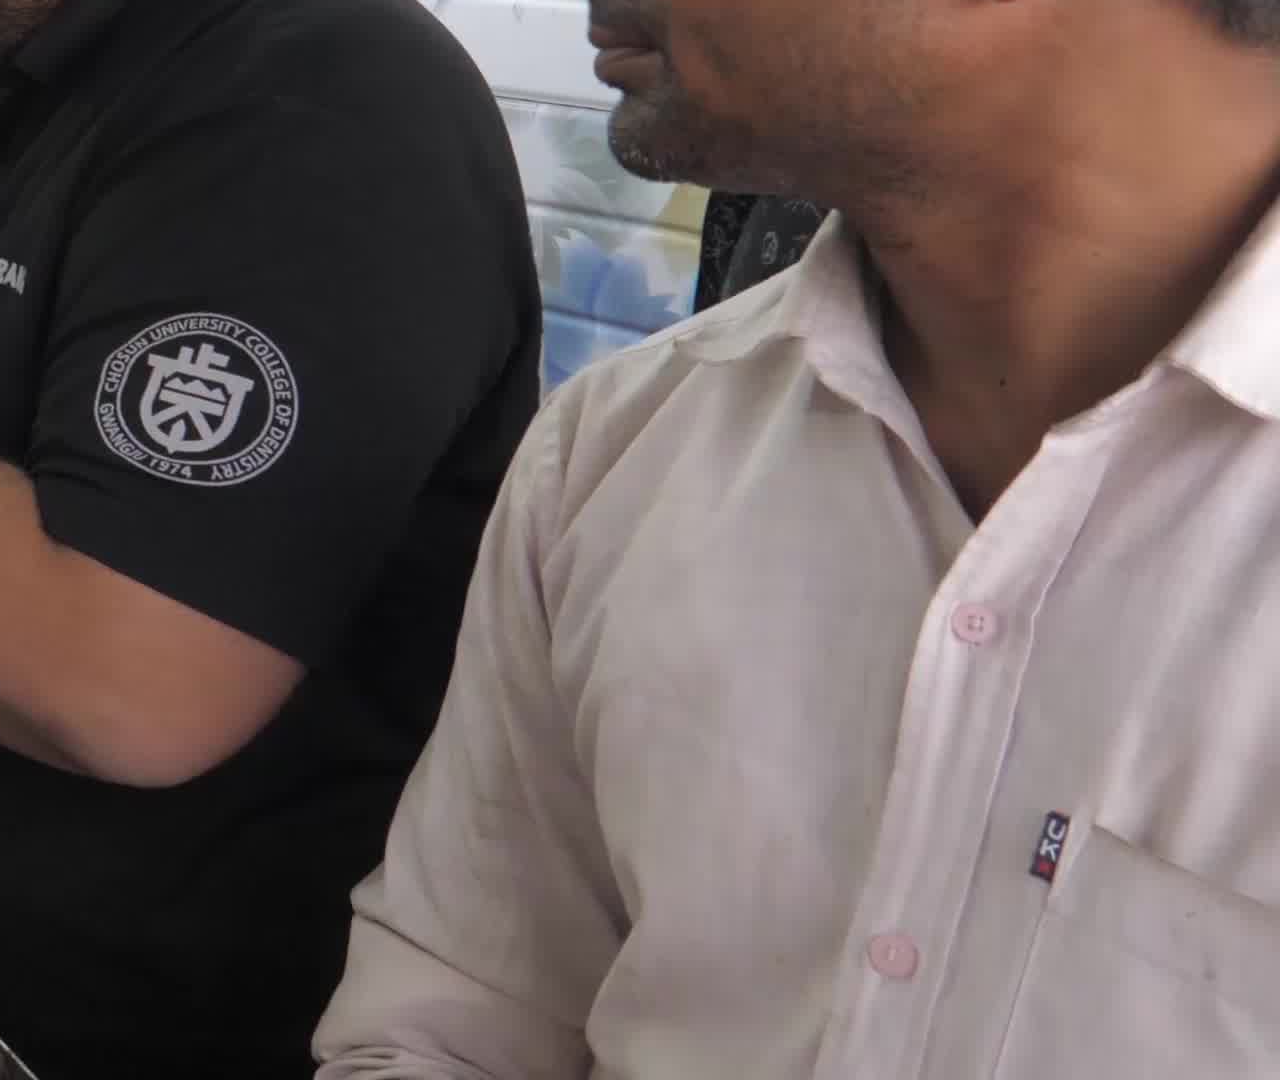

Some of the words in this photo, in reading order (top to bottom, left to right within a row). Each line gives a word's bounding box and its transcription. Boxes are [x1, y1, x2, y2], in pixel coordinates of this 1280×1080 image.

[149, 317, 245, 340] UNIVERSITY
[103, 337, 148, 392] CHOSUN
[244, 334, 292, 401] COLLEGE
[274, 404, 292, 426] OF
[149, 459, 193, 479] 1974
[210, 426, 288, 482] DENTISTRY
